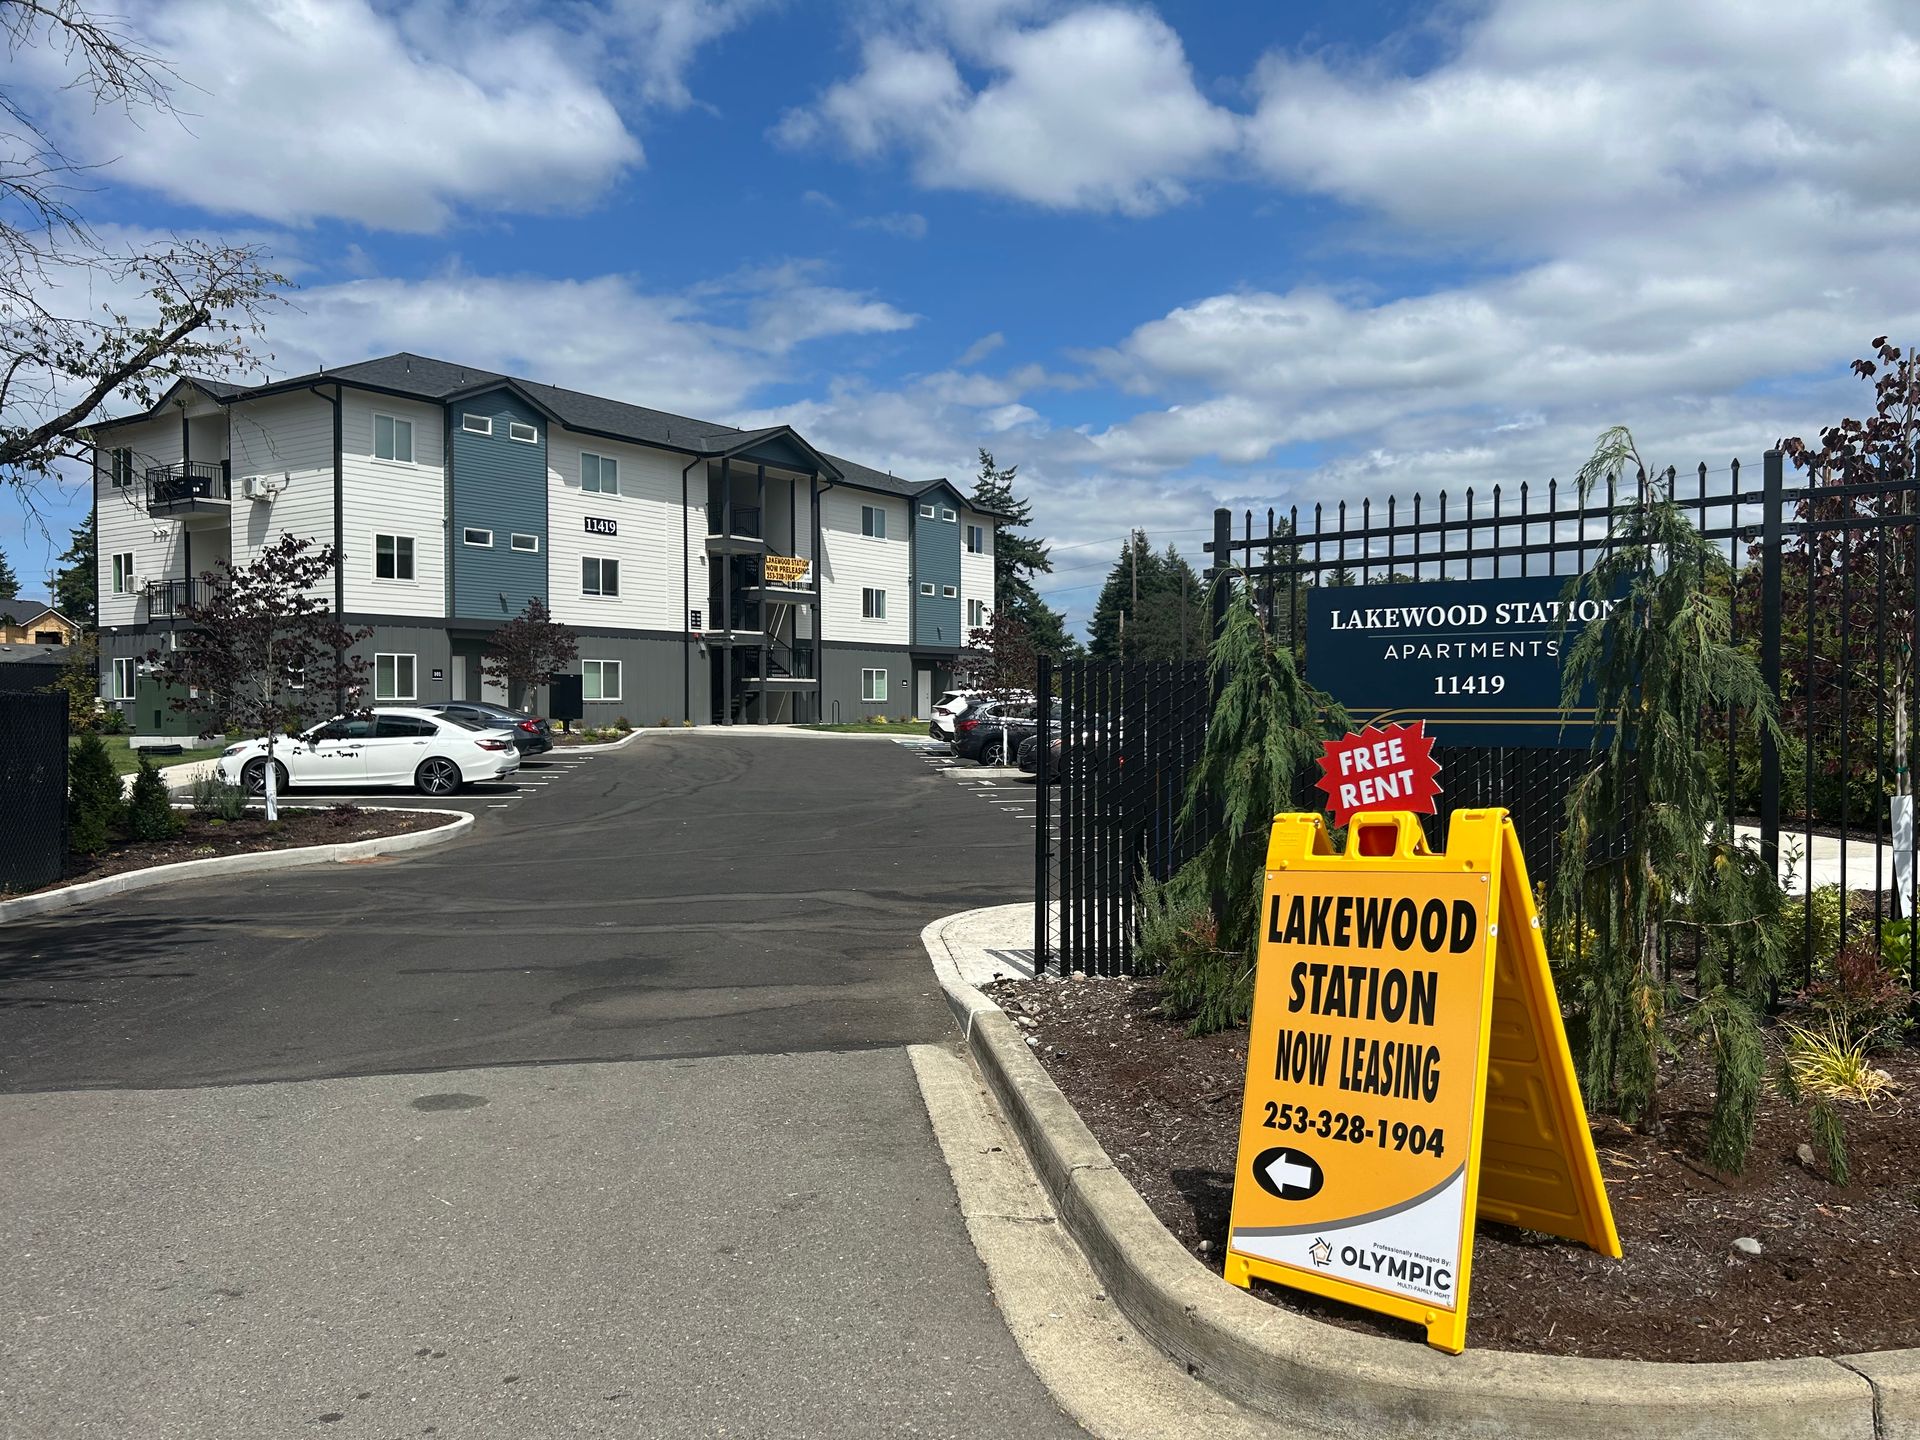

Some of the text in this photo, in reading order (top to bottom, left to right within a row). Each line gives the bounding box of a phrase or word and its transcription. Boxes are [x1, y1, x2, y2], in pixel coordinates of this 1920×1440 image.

[586, 518, 616, 533] 11419
[1331, 604, 1487, 630] LAKEWOOD
[1383, 640, 1559, 660] APARTMENTS
[1434, 675, 1505, 695] 11419
[1339, 738, 1405, 776] FREE
[1340, 769, 1414, 809] RENT
[1267, 895, 1477, 954] LAKEWOOD
[1288, 961, 1438, 1026] STATION
[1274, 1029, 1440, 1103] NOW LEASING
[1262, 1101, 1445, 1158] 253-328-1904
[1340, 1245, 1452, 1291] OLYMPIC
[1373, 1242, 1413, 1257] Professionally
[1414, 1252, 1440, 1264] Managed
[1396, 1281, 1451, 1300] MULTI-FAMILY MGMT
